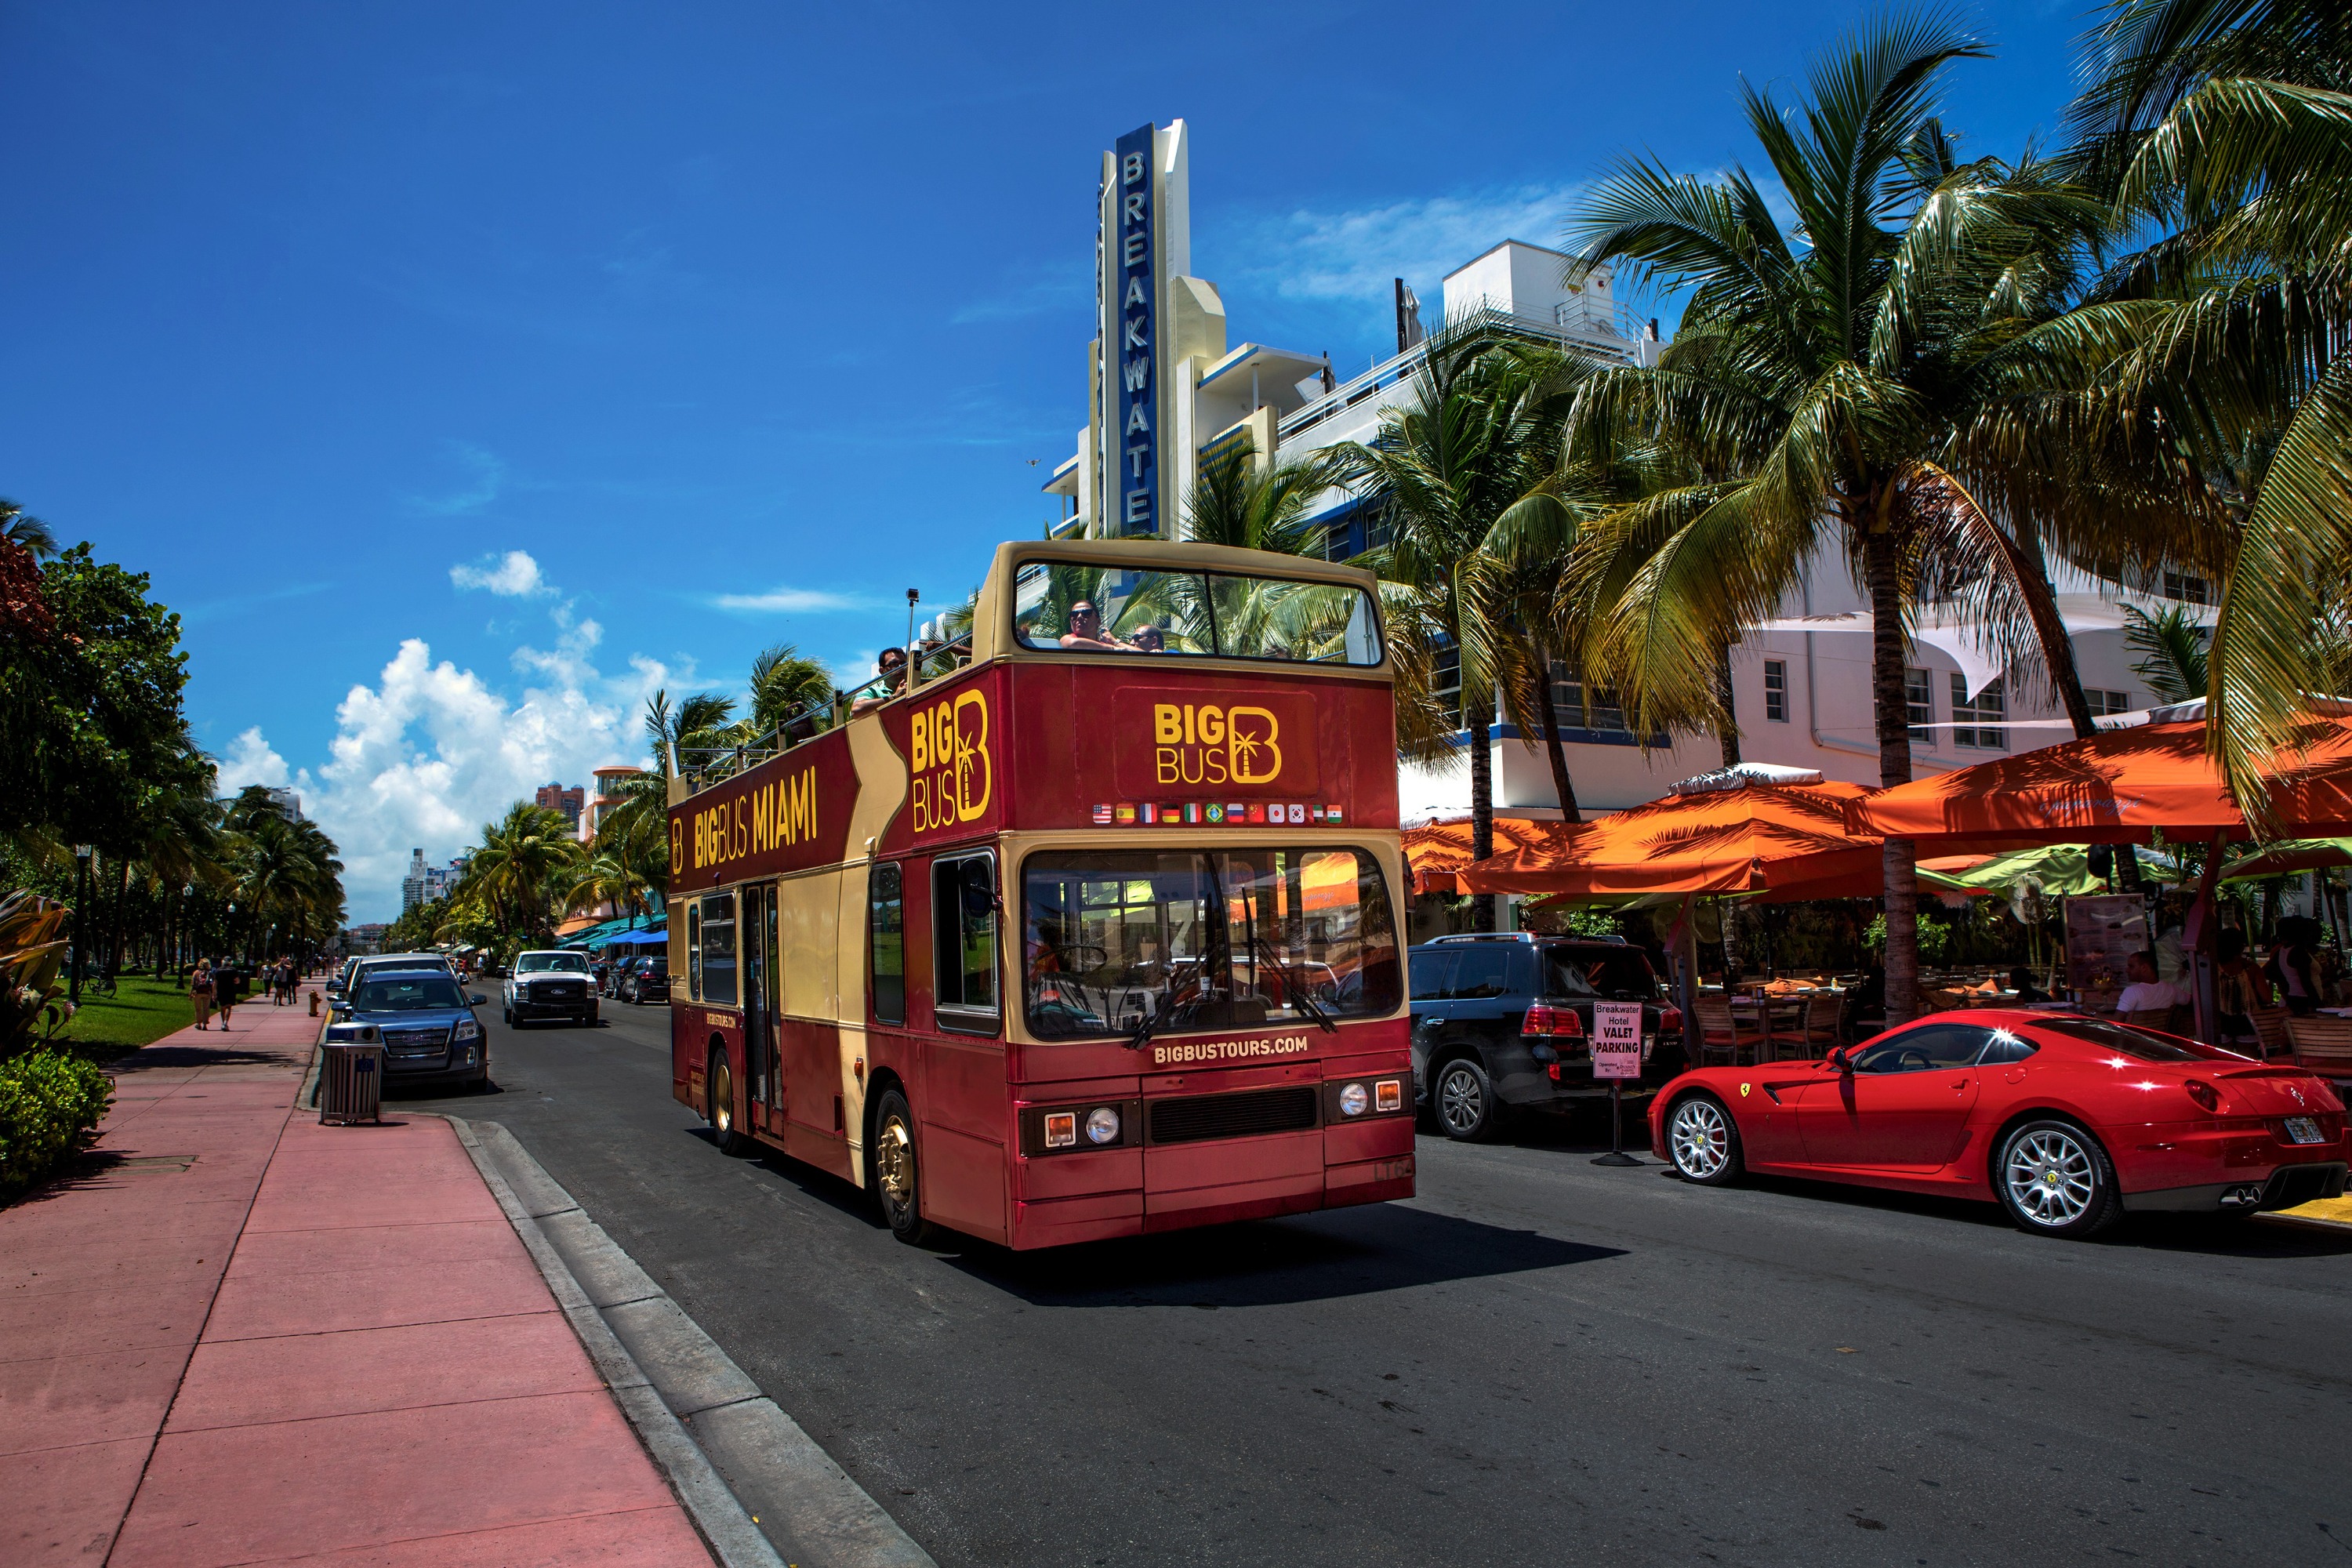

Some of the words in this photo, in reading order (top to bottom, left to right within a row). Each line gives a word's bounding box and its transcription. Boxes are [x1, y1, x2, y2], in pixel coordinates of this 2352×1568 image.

[911, 701, 953, 774] BIG
[1154, 703, 1225, 745] BIG
[1156, 747, 1227, 784] BUS
[753, 765, 817, 855] MIAMI
[913, 769, 956, 833] BUS
[1596, 1005, 1639, 1014] Breakwater
[1155, 1036, 1308, 1064] BIGBUSTOURS.COM
[1596, 1042, 1638, 1053] PARKING
[1603, 1027, 1633, 1038] VALET
